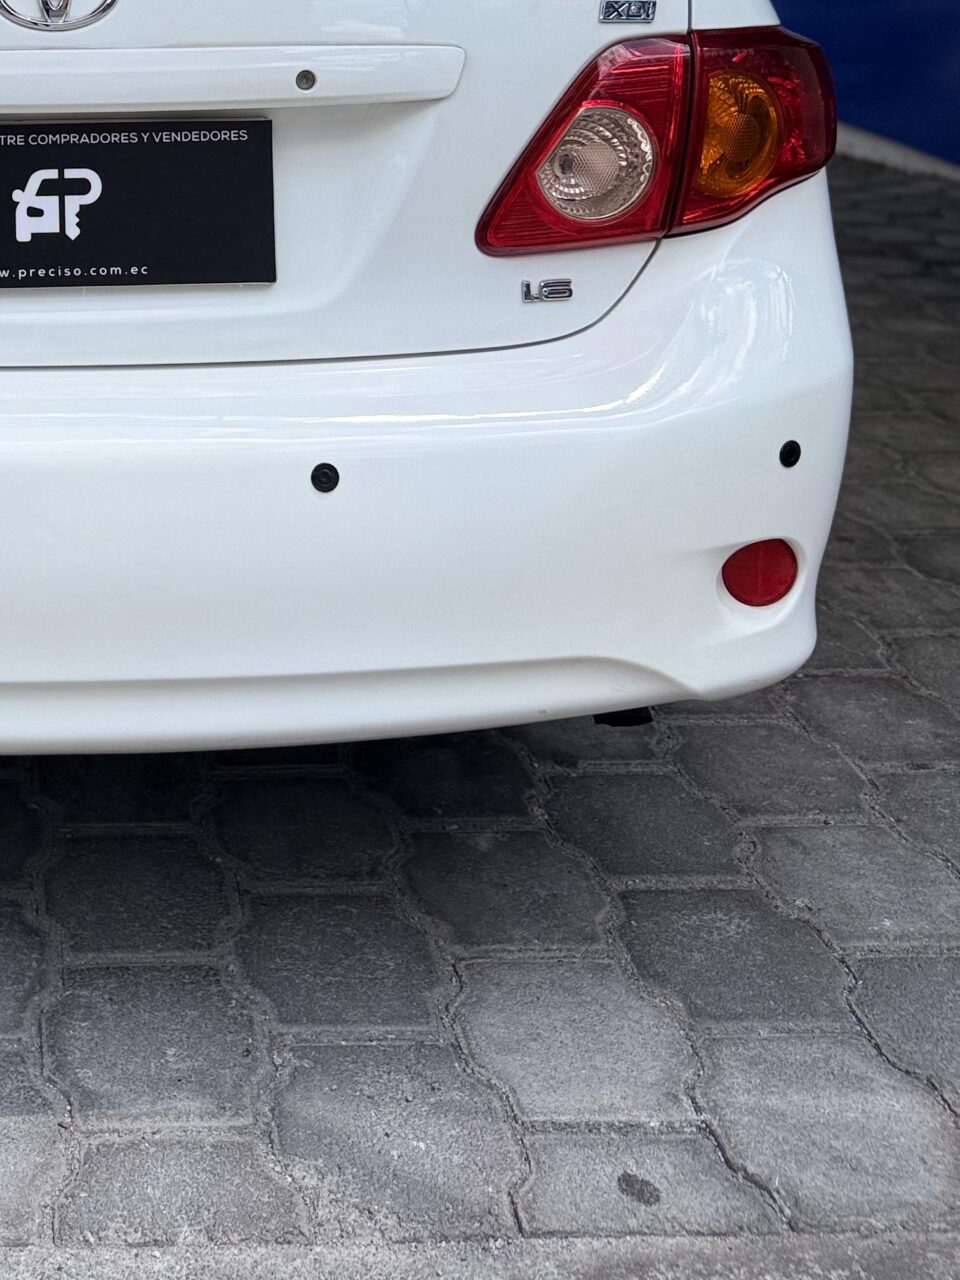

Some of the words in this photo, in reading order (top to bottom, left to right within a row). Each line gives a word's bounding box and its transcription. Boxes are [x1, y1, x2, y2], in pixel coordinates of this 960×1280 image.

[28, 133, 138, 145] COMPRADORES
[141, 132, 150, 142] Y
[152, 130, 248, 143] VENDEDORES
[521, 278, 573, 303] 1.6
